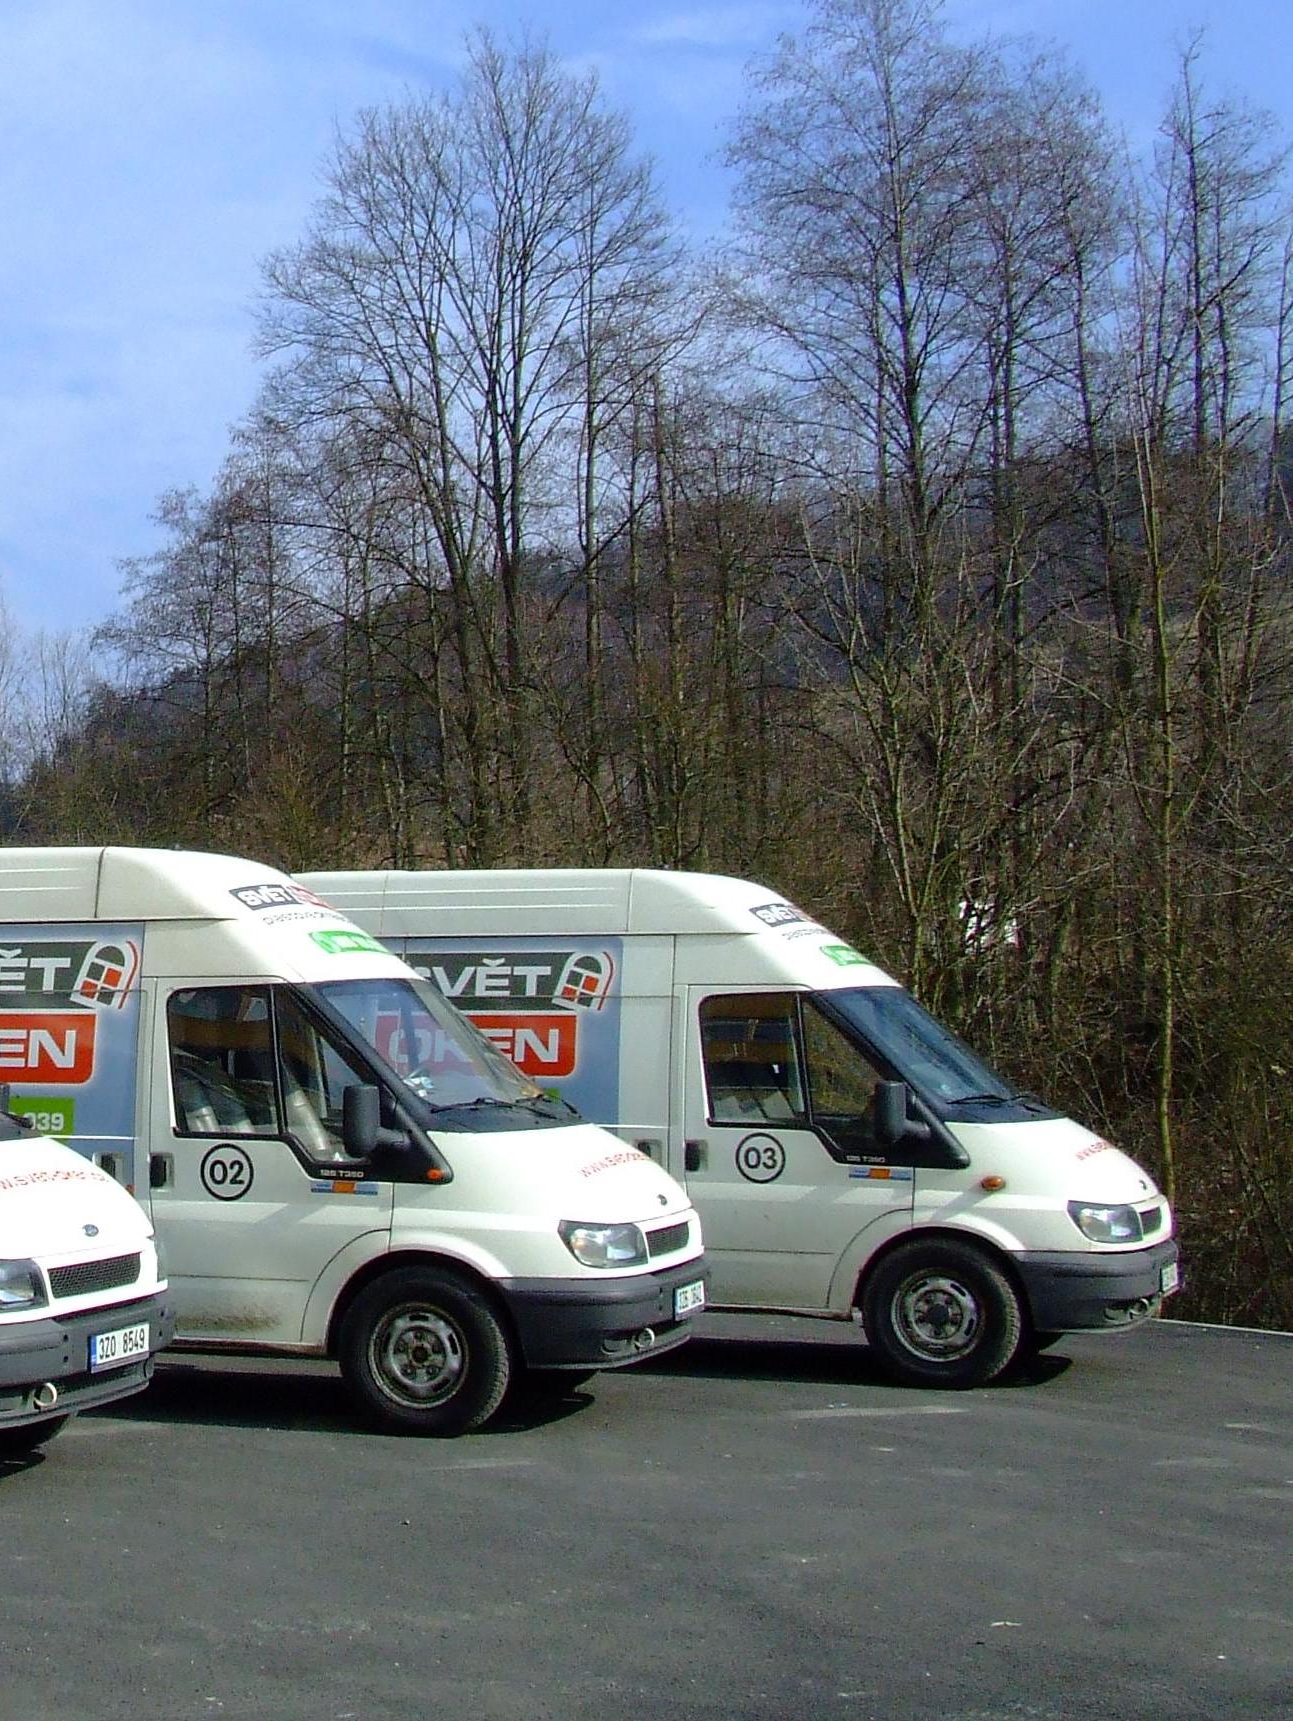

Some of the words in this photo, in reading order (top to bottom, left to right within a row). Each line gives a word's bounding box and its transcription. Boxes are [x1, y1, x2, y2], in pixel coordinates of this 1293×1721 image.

[744, 1146, 777, 1170] 03
[209, 1159, 245, 1185] 02
[122, 1327, 145, 1353] 8549
